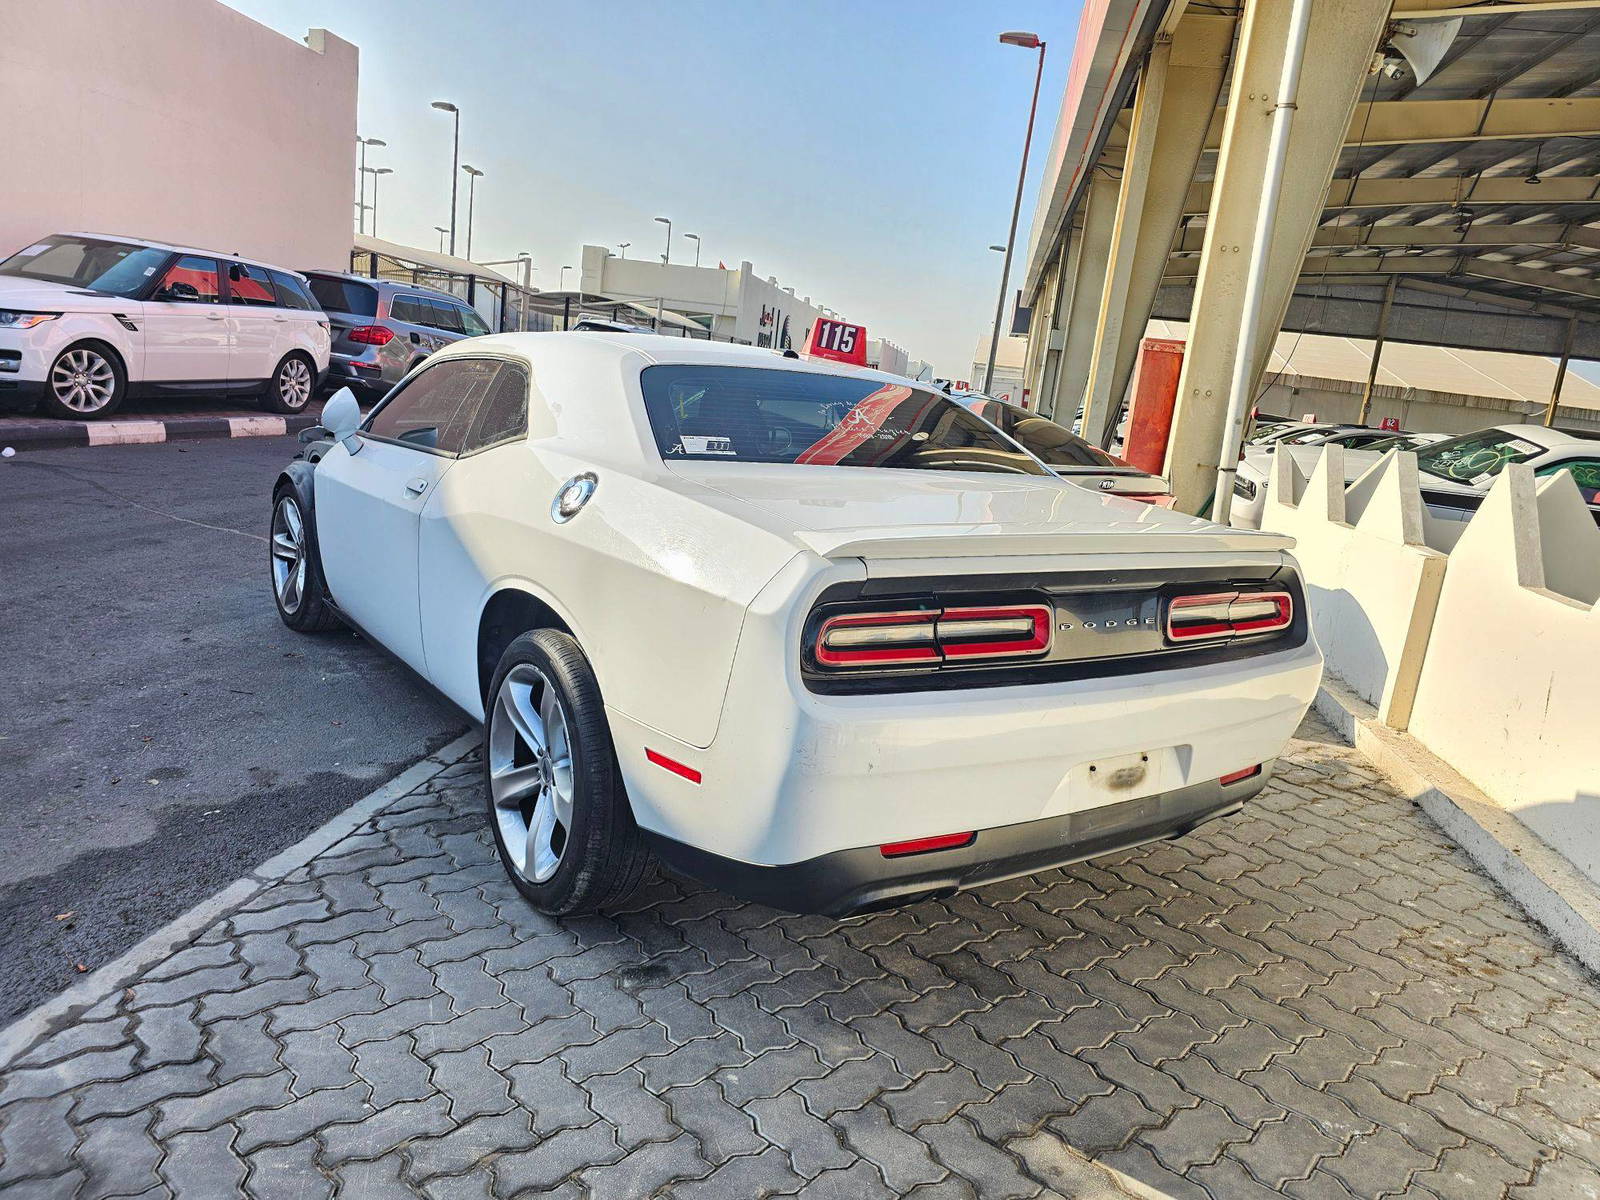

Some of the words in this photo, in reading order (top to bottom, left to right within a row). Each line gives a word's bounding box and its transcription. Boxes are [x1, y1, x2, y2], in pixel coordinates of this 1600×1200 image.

[820, 321, 856, 353] 115
[665, 443, 686, 454] A
[1059, 617, 1157, 632] DODGE
